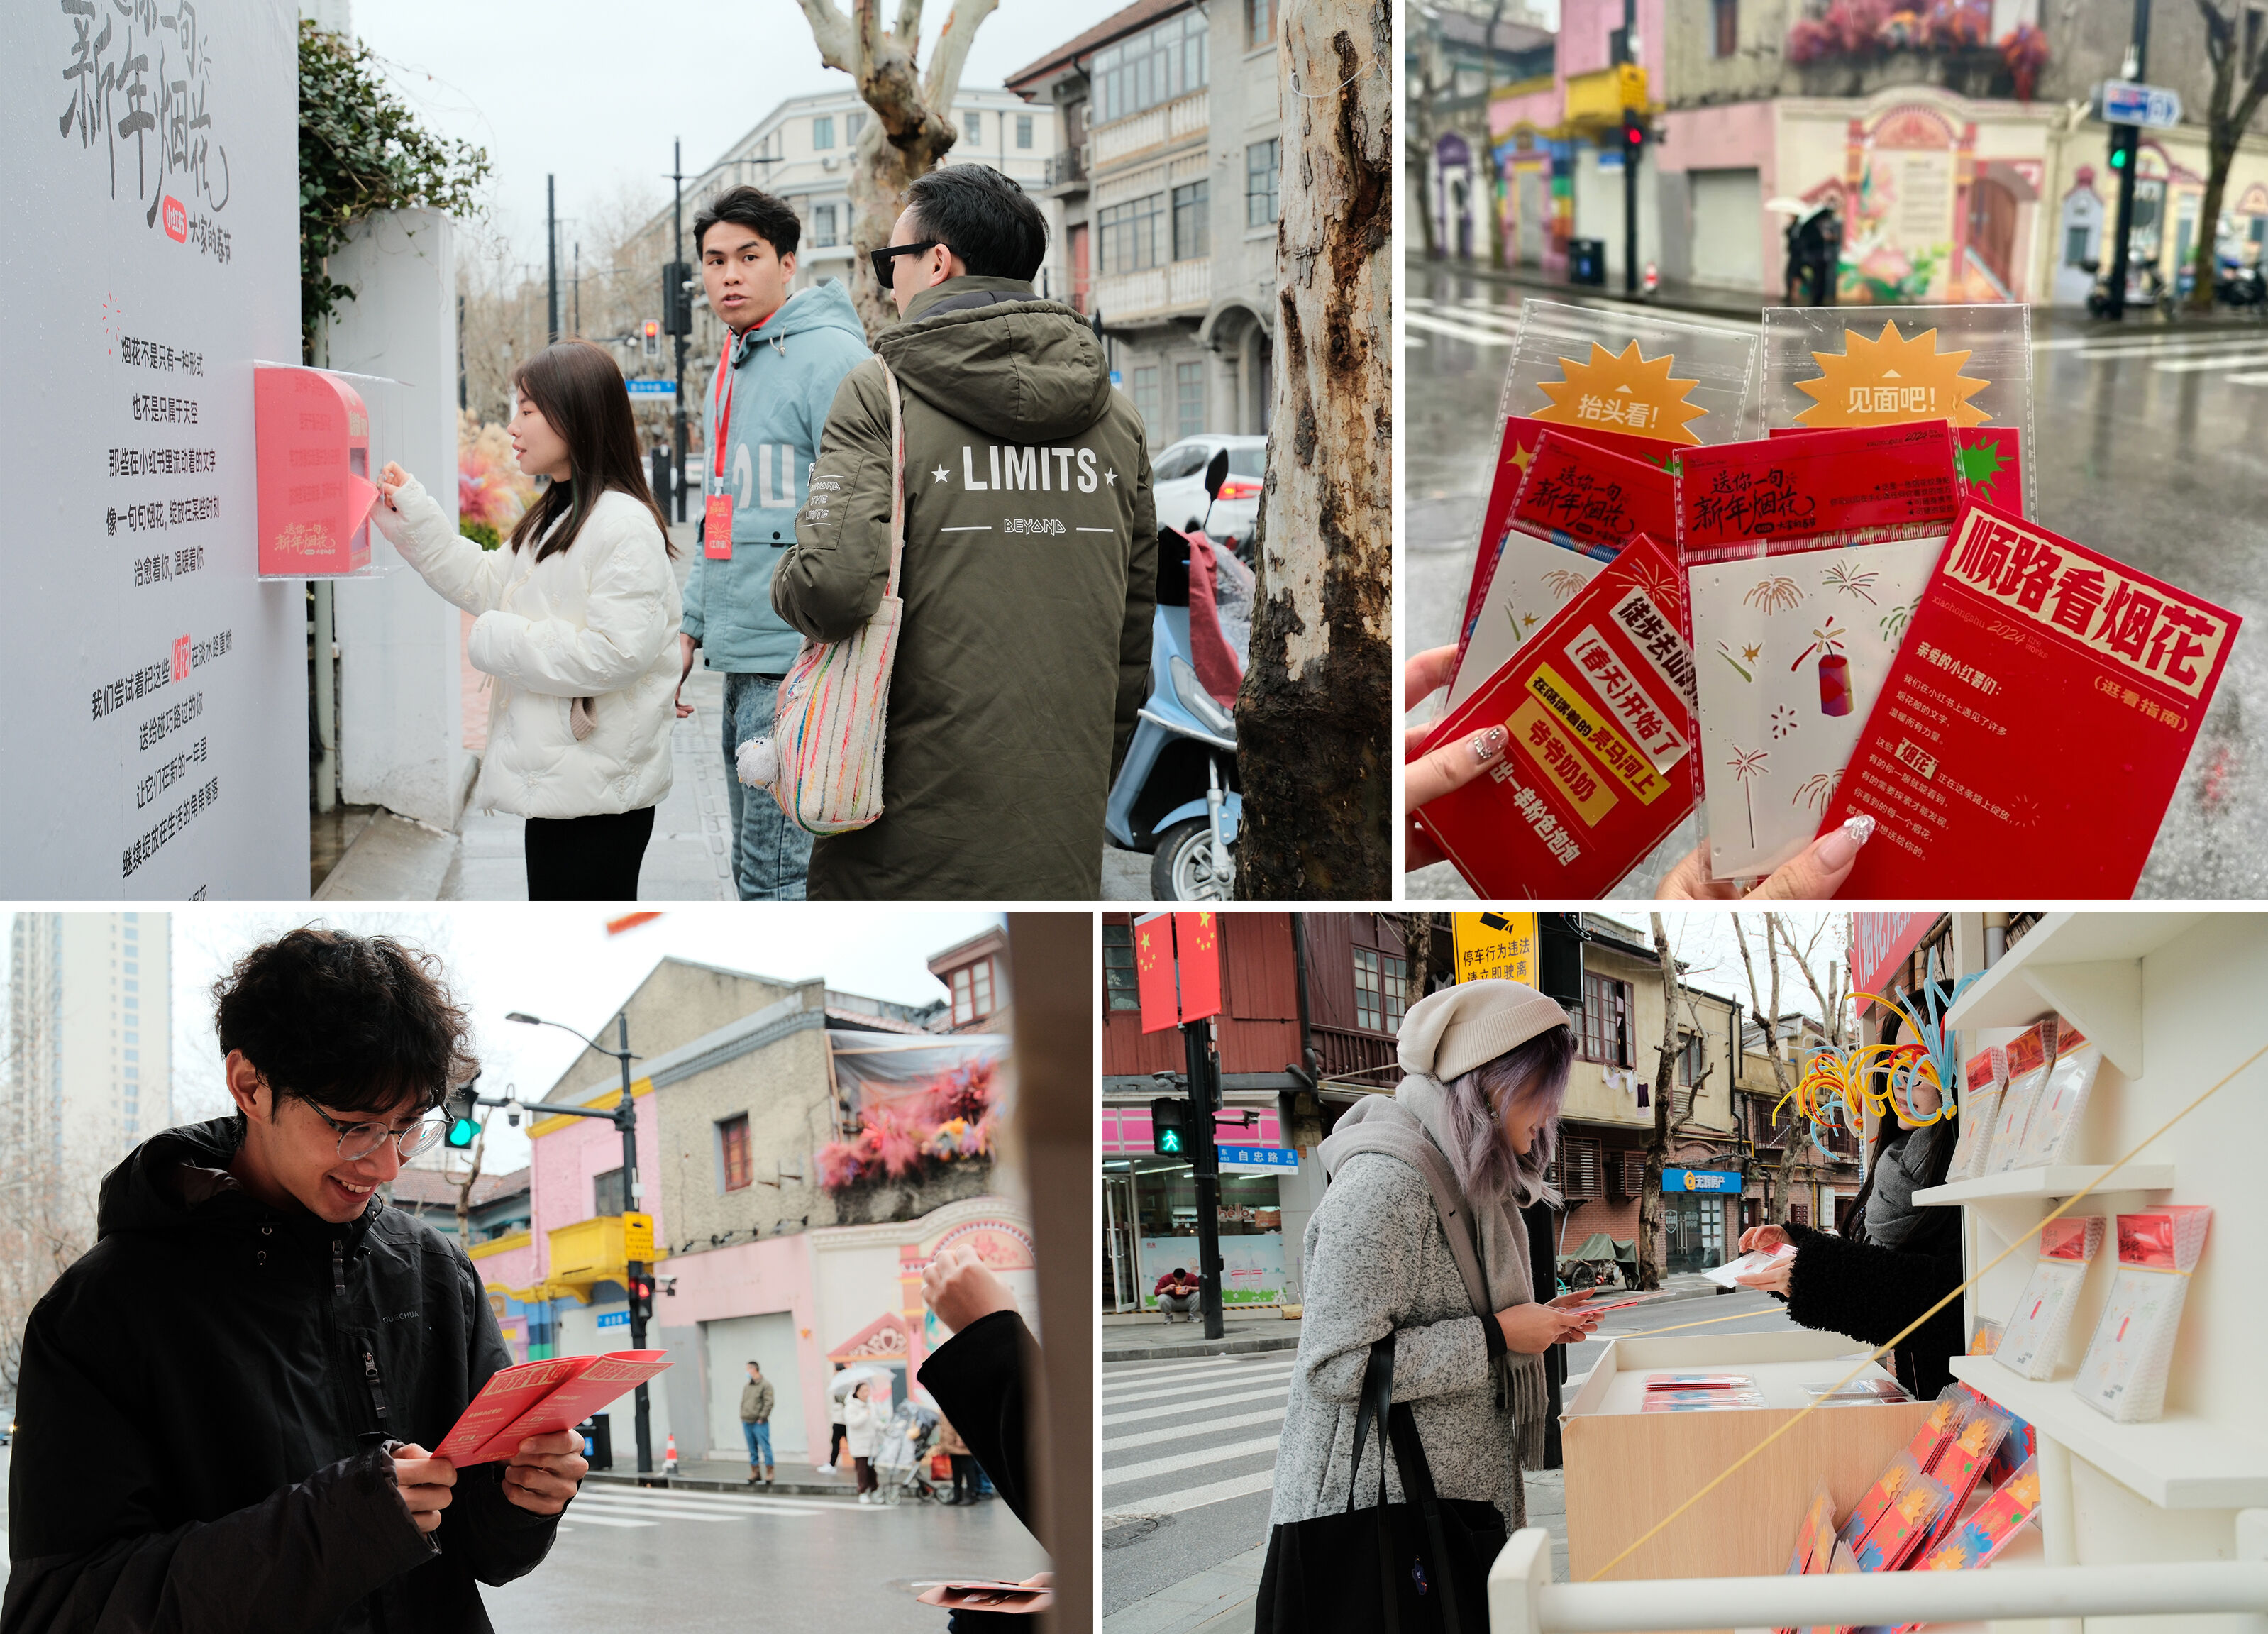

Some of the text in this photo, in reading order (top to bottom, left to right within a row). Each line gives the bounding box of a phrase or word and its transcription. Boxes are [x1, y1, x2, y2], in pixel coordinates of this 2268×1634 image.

[165, 204, 231, 265] 小红书 大家的春节
[121, 335, 204, 377] 烟花不是只有一种形式
[132, 392, 199, 425] 也不是只属于天空
[1577, 392, 1659, 430] 抬头看！
[1847, 385, 1937, 414] 见面吧！
[1904, 431, 1927, 443] 2024
[109, 447, 216, 477] 那些在小红书里流动着的文字
[962, 445, 1098, 494] LIMITS
[810, 495, 829, 506] THE
[1556, 465, 1622, 502] 送你一句
[1710, 468, 1783, 495] 送你一句
[805, 509, 829, 521] LIMITS
[1527, 478, 1635, 533] 新年烟花
[1691, 485, 1816, 536] 新年烟花
[1004, 518, 1066, 536] BEYOND
[1955, 514, 2218, 688] 顺路看烟花
[1932, 595, 1986, 629] xiaohongshu
[1986, 620, 2026, 646] 2024
[1915, 641, 2002, 695] 亲爱的小红薯们：
[2025, 641, 2049, 660] works
[139, 691, 204, 753] 送给碰巧路过的你
[1903, 673, 2008, 736] 我们在小红书上遇见了许多
[1875, 736, 1894, 753] 这些
[1888, 707, 1945, 746] 温暖而有力量。
[136, 736, 208, 810] 让它们在新的一年里
[1528, 719, 1598, 802] 爷爷奶奶
[122, 775, 219, 880] 继续绽放在生活的角角落落
[1463, 937, 1531, 967] 停车行为违法
[1238, 1149, 1278, 1163] 自忠路
[382, 1310, 419, 1323] QUECHUA
